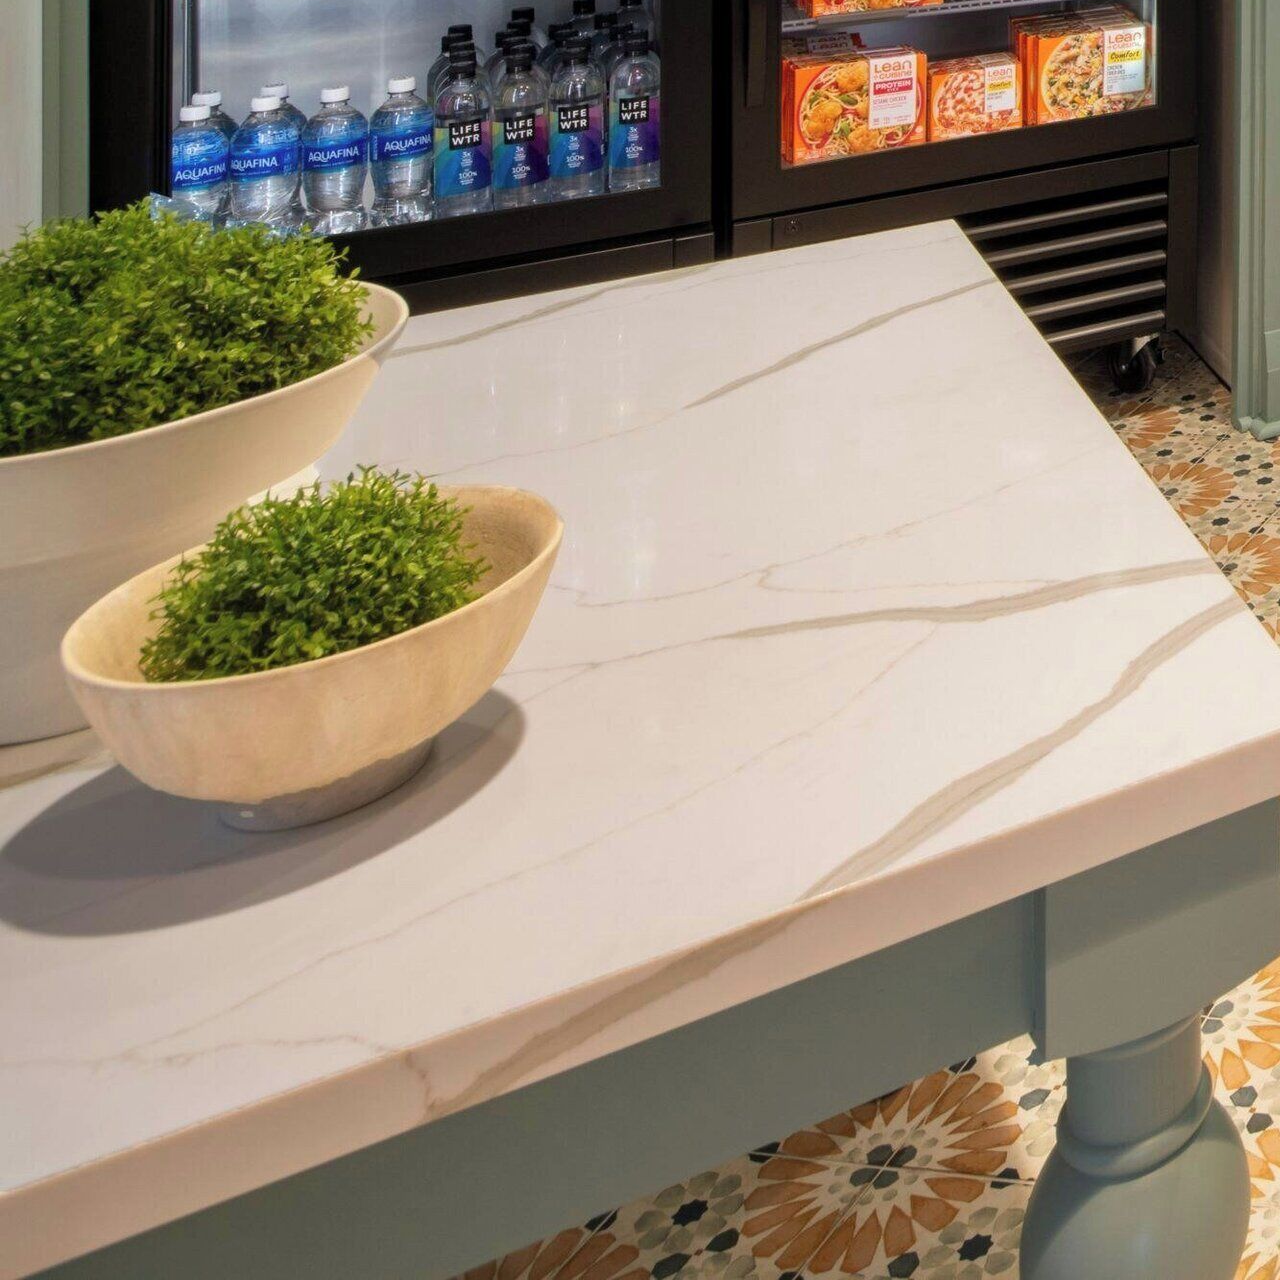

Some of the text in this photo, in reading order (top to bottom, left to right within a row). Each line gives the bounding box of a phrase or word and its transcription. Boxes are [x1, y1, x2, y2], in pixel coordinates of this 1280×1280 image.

[1108, 32, 1142, 44] Lean
[1110, 51, 1140, 60] Comfort
[874, 60, 912, 73] Lean
[875, 80, 911, 91] PROTEIN
[621, 100, 647, 111] LIFE
[560, 108, 587, 120] LIFE
[621, 110, 647, 121] WTR
[452, 123, 480, 135] LIFE
[506, 118, 534, 130] LIFE
[560, 119, 587, 130] WTR
[452, 133, 480, 146] WTR
[506, 129, 534, 140] WTR
[384, 133, 432, 152] AQUAFINA
[308, 146, 360, 162] AQUAFINA
[174, 162, 227, 181] AQUAFINA
